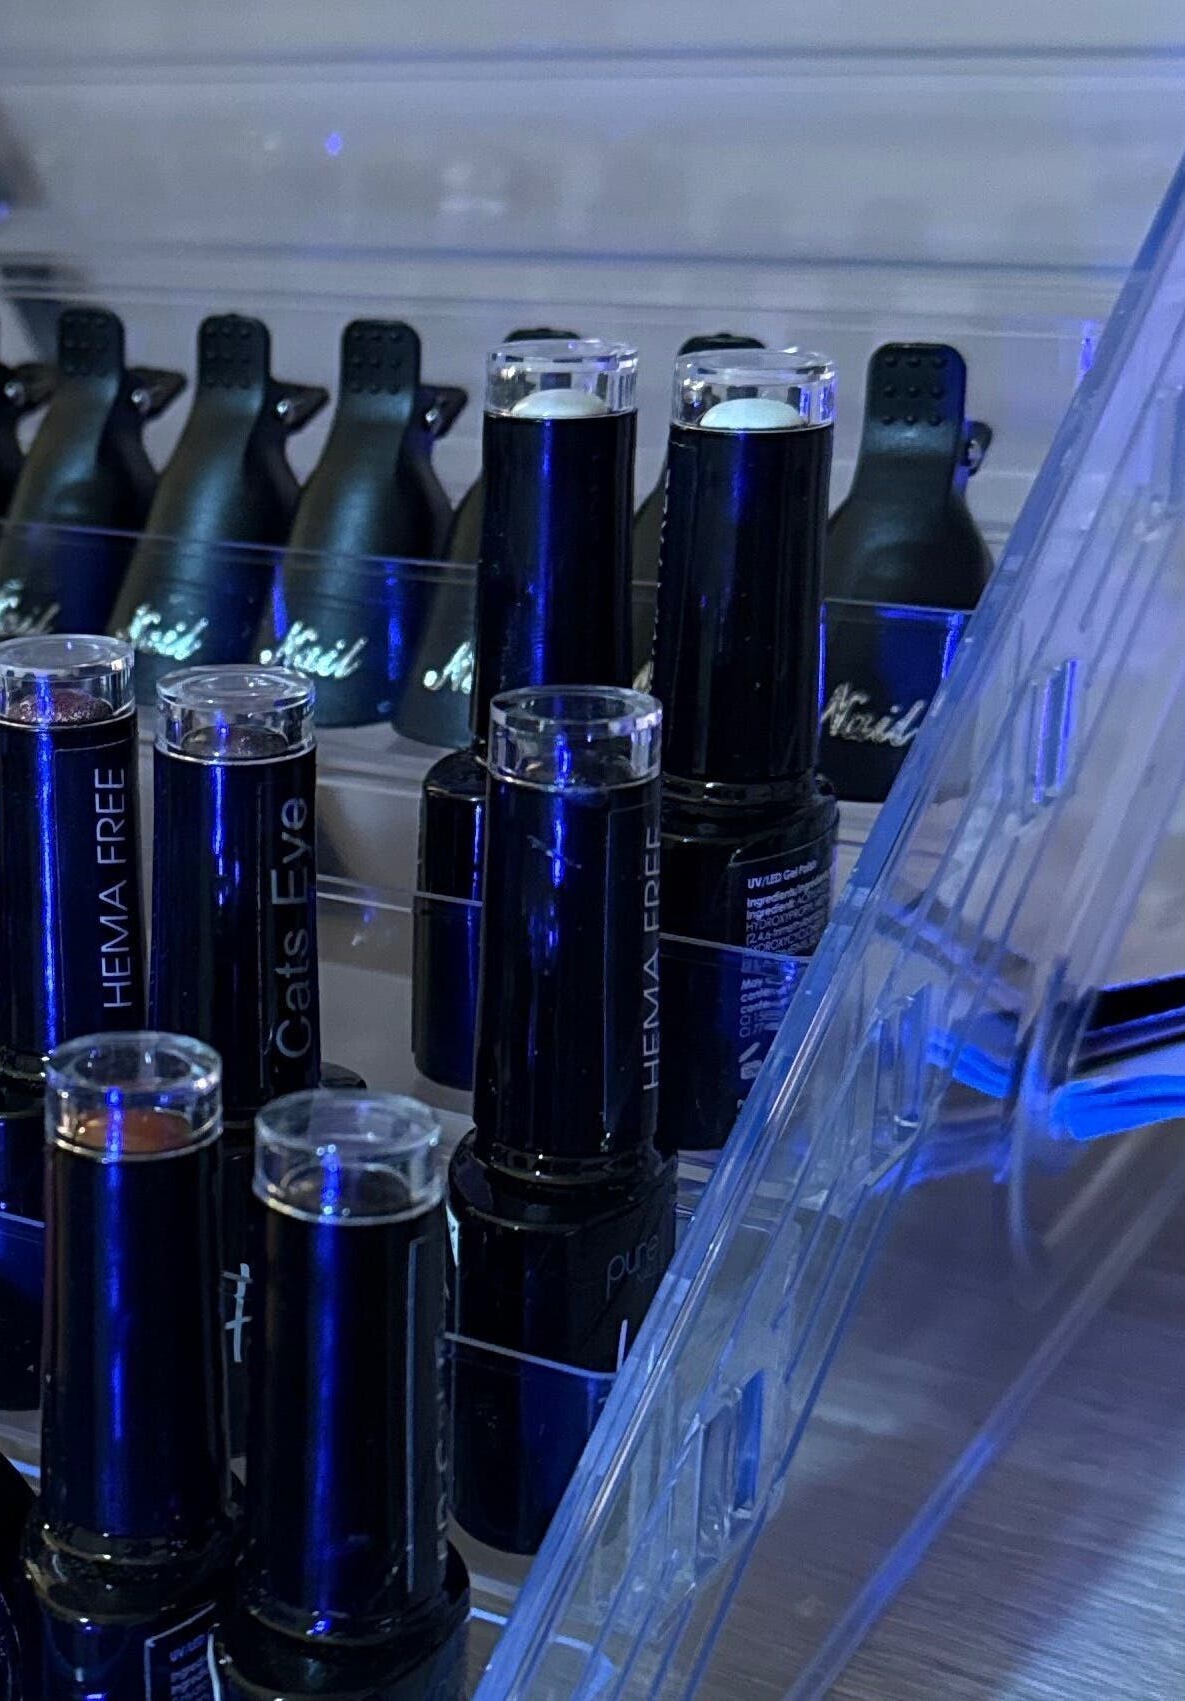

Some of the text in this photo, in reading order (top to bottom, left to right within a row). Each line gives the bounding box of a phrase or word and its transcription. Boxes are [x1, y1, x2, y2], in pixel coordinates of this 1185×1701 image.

[820, 682, 929, 747] Nail
[94, 768, 133, 1008] HEMA FREE
[270, 797, 312, 1059] Cats Eye
[642, 826, 661, 1091] HEMA FREE
[606, 1233, 659, 1300] pure
